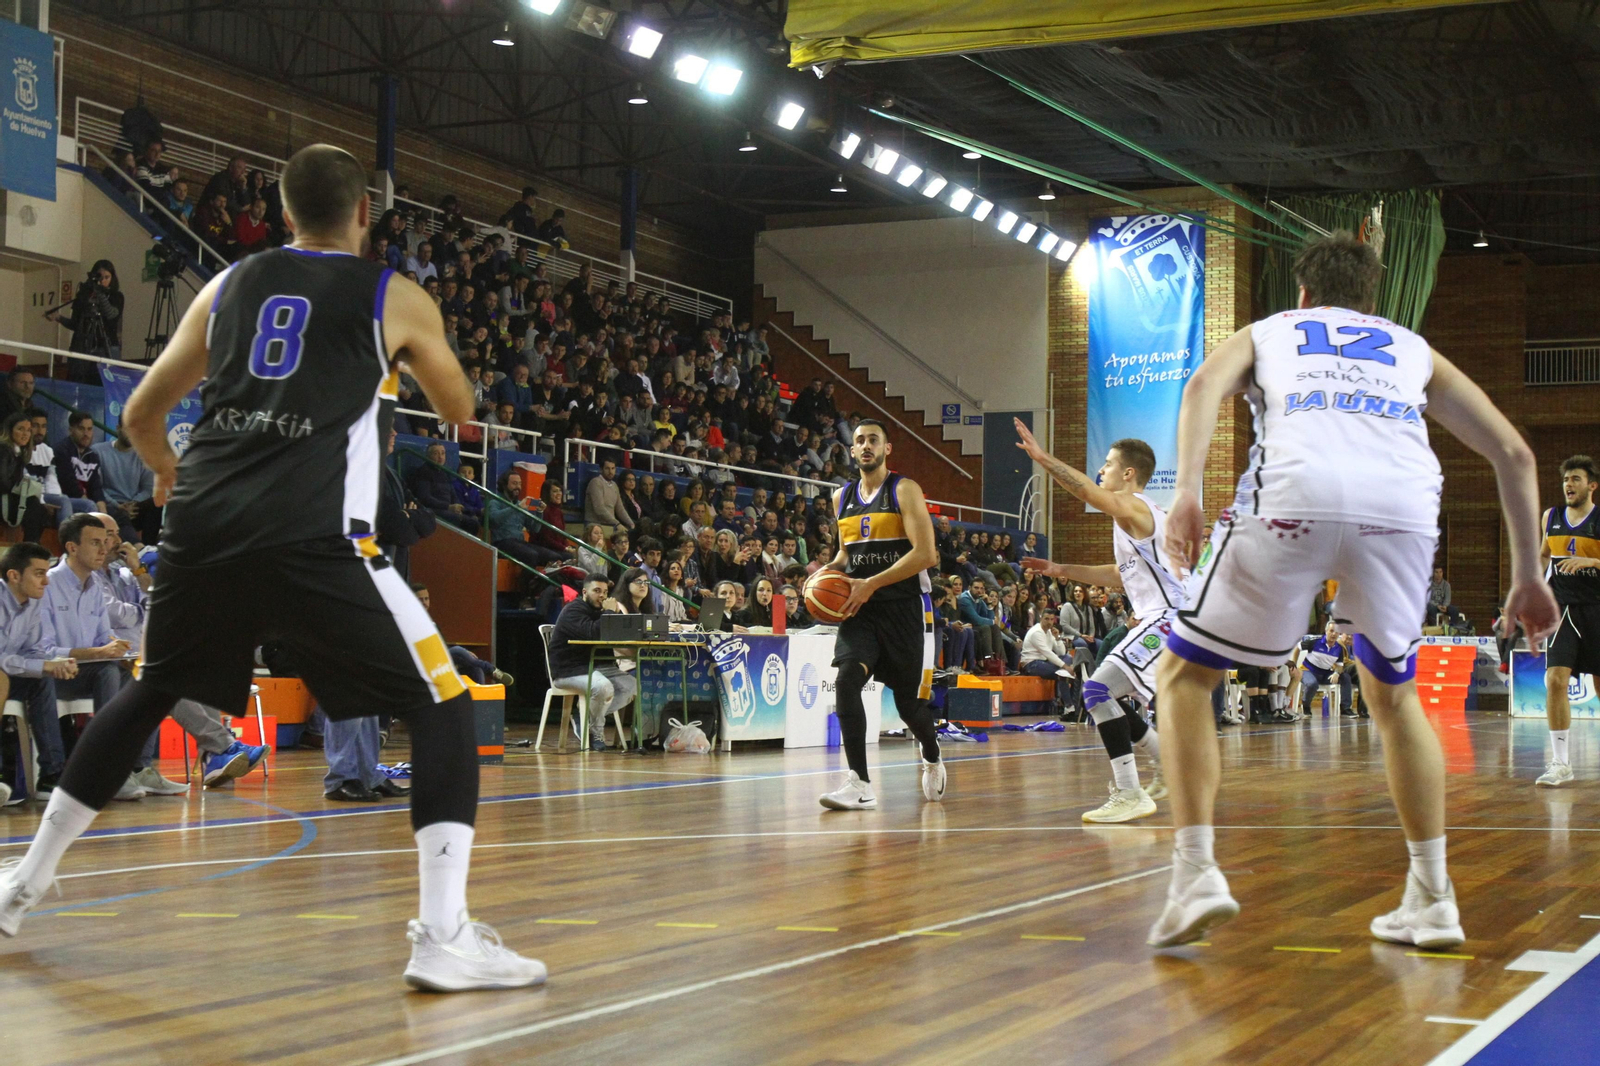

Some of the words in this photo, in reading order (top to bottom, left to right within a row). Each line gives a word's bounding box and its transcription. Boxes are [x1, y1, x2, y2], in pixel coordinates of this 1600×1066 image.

[3, 107, 52, 130] Ayuntamiento
[10, 120, 19, 131] de
[20, 123, 46, 139] Huelva
[1134, 246, 1145, 256] ET
[1144, 234, 1168, 251] TERRA
[33, 291, 55, 306] 117
[248, 294, 312, 380] 8
[1294, 320, 1396, 367] 12
[1104, 348, 1190, 377] Apoyamos
[1336, 361, 1366, 374] LA
[1104, 374, 1124, 388] tu
[1128, 367, 1191, 394] esfuerzo
[1284, 390, 1327, 416] LA
[1332, 389, 1423, 428] LÍNEA
[860, 516, 871, 538] 6
[1566, 537, 1576, 556] 4
